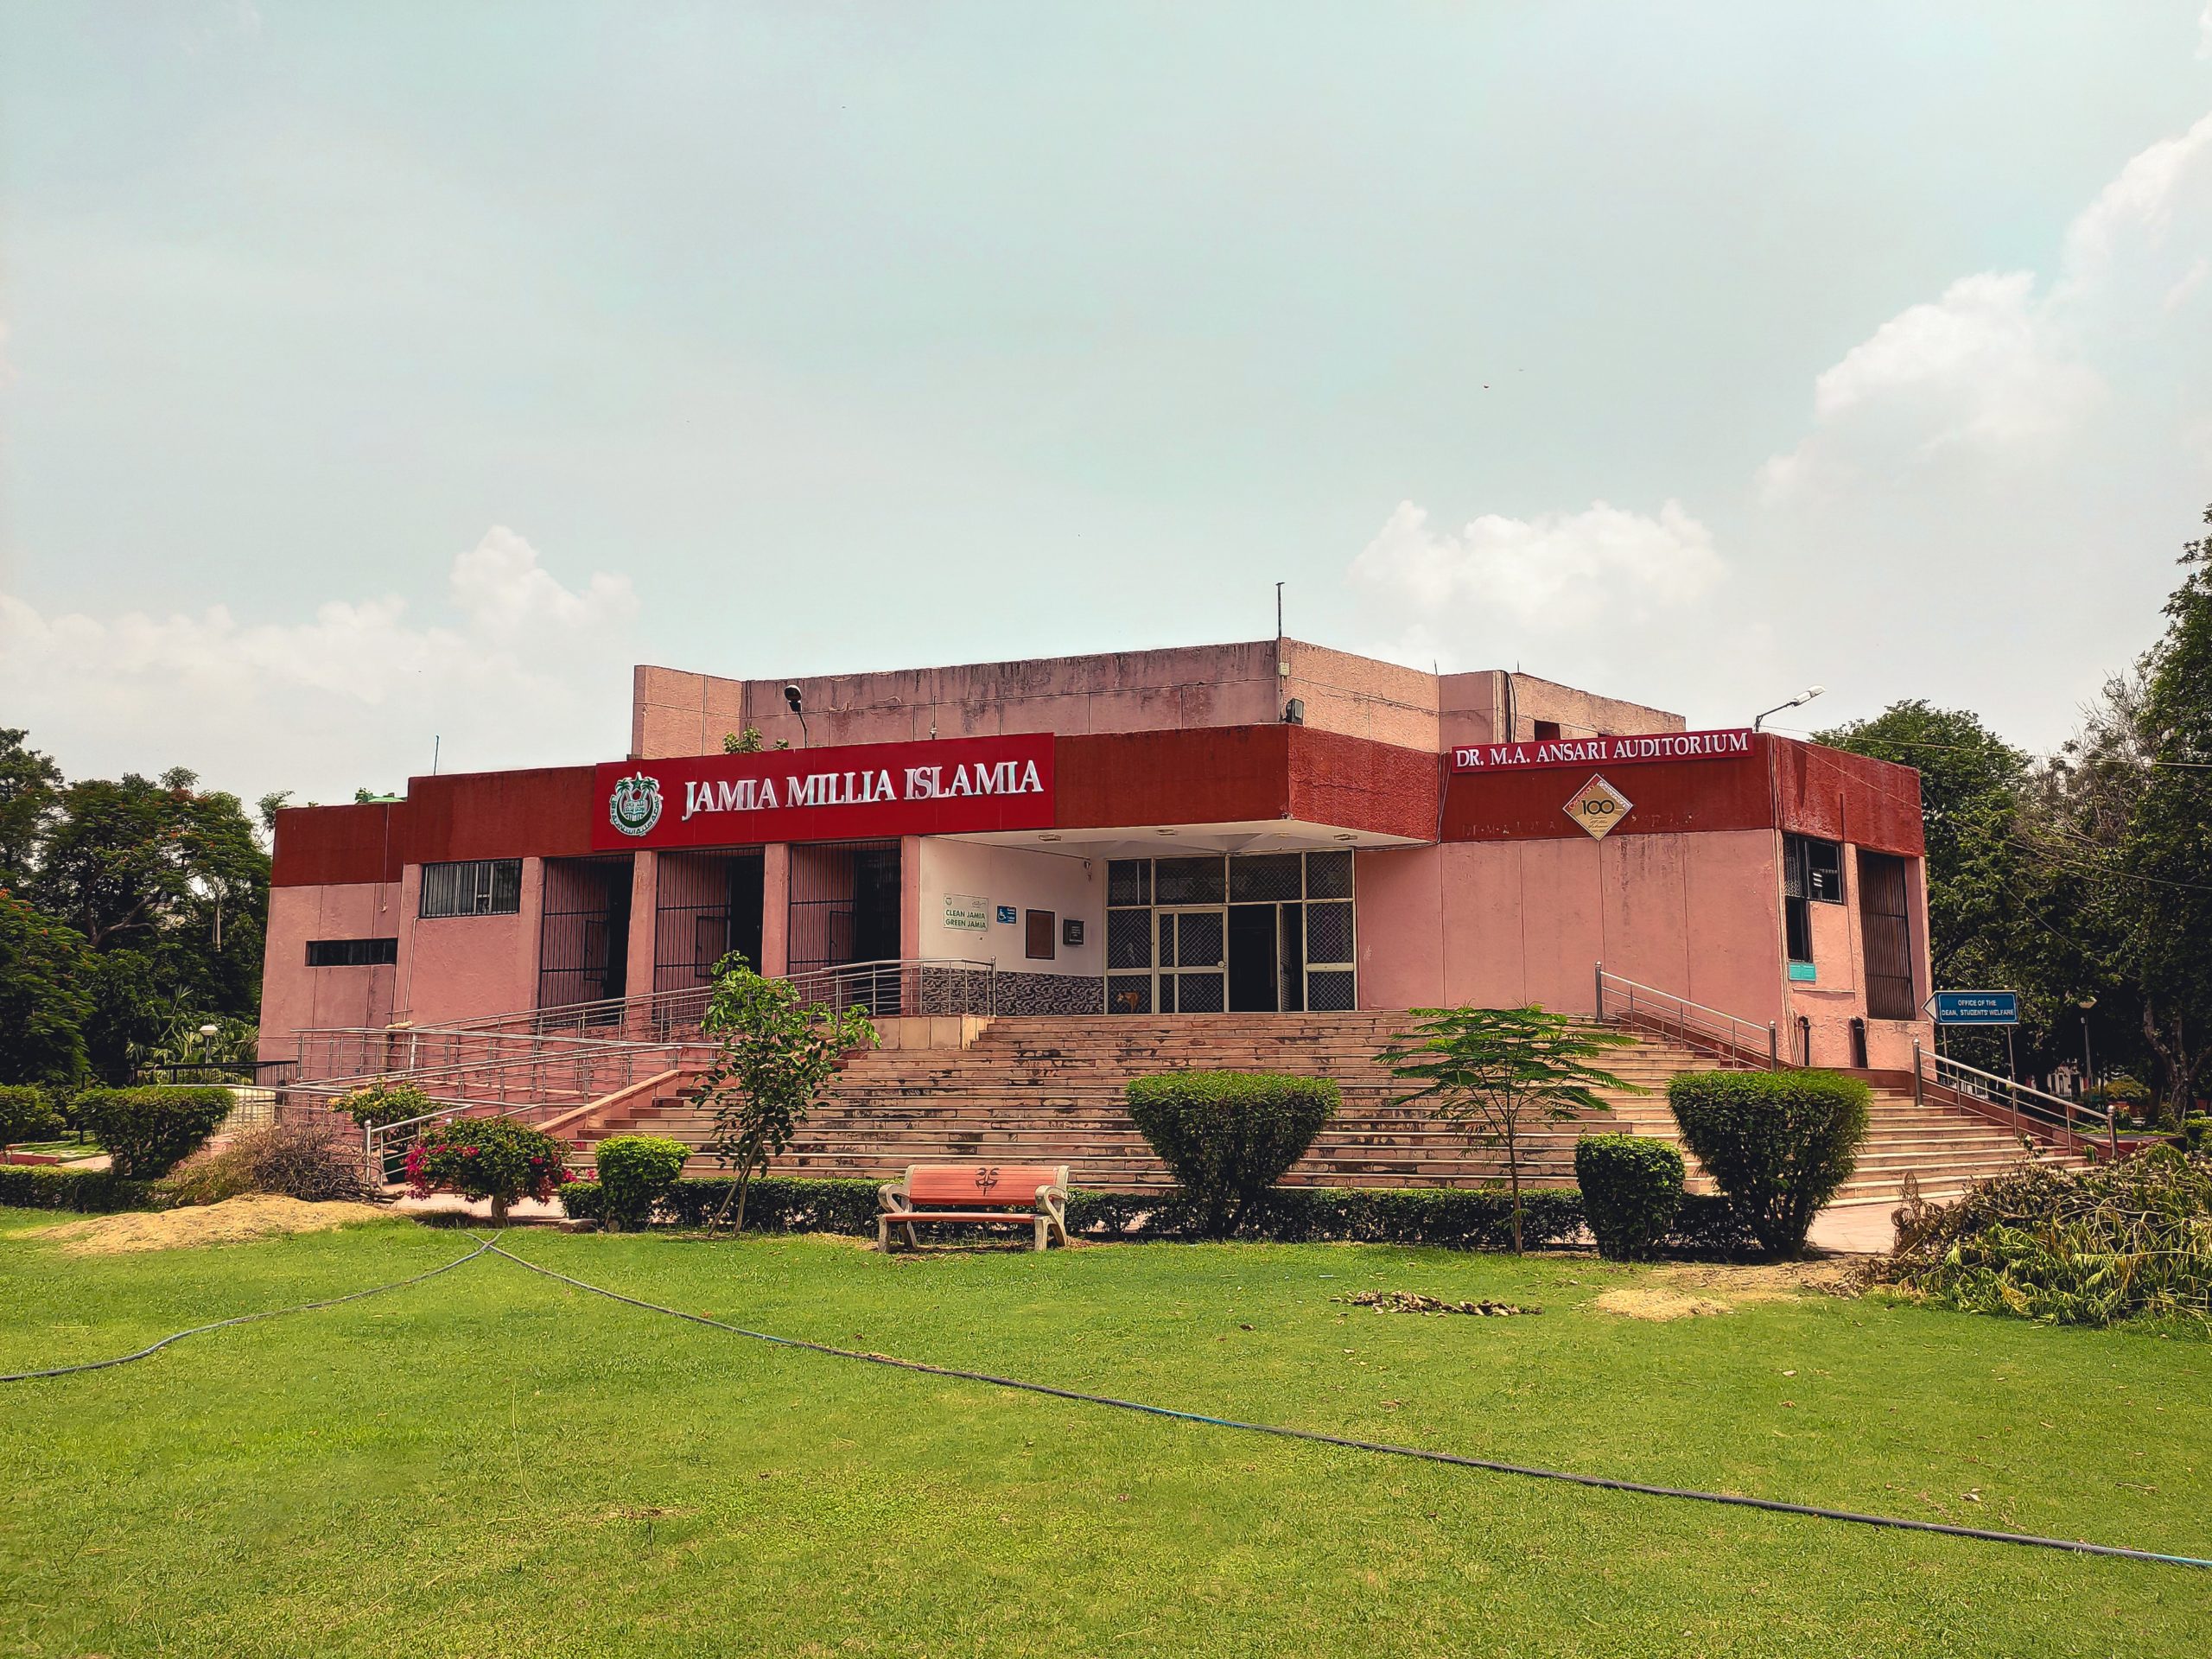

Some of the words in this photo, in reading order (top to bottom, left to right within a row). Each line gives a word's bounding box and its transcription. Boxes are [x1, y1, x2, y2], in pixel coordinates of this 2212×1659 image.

[1455, 748, 1484, 767] DR.
[1490, 746, 1530, 766] M.A.
[1535, 741, 1608, 762] ANSARI
[1612, 732, 1749, 759] AUDITORIUM
[682, 778, 779, 821] JAMIA
[785, 769, 897, 808] MILLIA
[903, 760, 1045, 800] ISLAMIA
[1581, 799, 1615, 816] 100
[945, 909, 965, 918] CLEAN
[967, 911, 986, 919] JAMIA
[945, 918, 966, 927] GREEN
[967, 920, 987, 929] JAMIA
